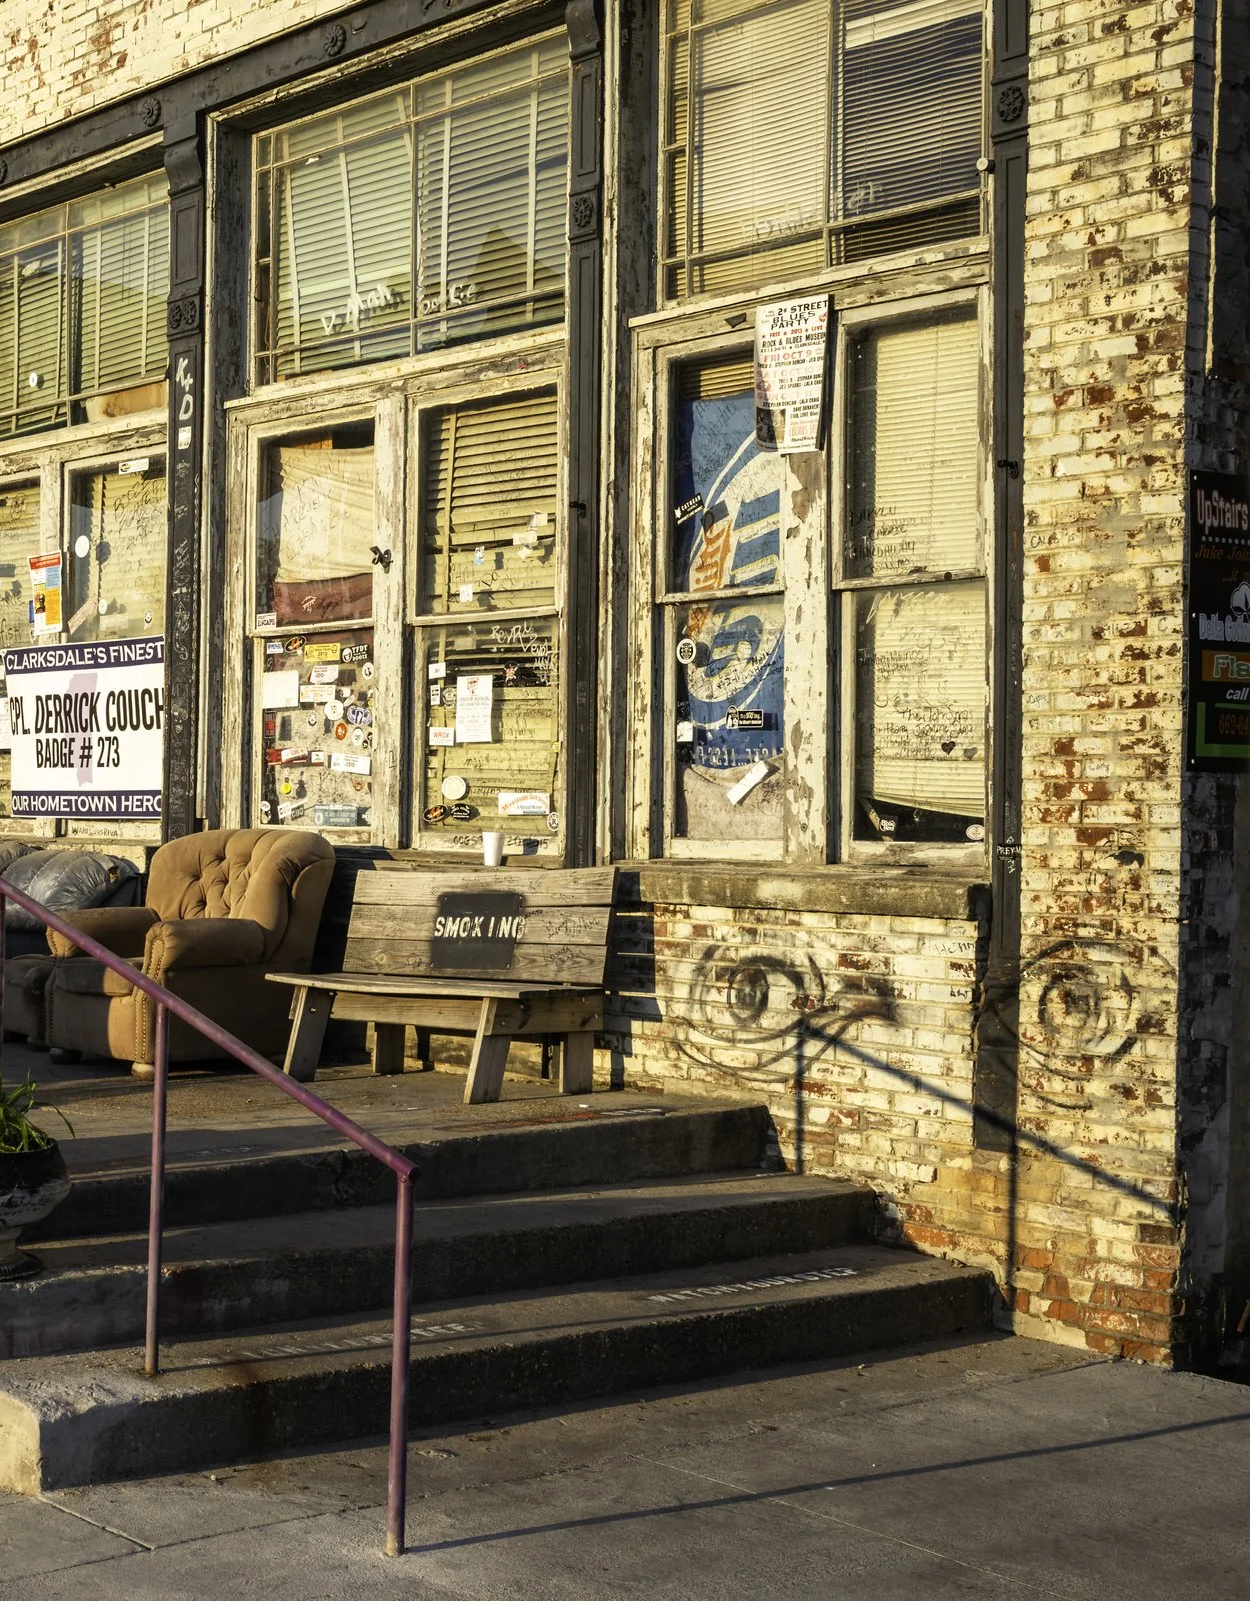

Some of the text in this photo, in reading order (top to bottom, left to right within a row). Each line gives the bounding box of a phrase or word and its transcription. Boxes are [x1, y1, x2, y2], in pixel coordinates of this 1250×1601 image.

[790, 300, 828, 314] STREET
[770, 318, 809, 331] PARTY
[772, 311, 816, 324] BLUES
[762, 340, 776, 349] ROCK
[786, 335, 803, 345] BLUES
[763, 353, 780, 363] FRI
[783, 350, 803, 360] OCT
[1197, 489, 1249, 535] UpStairs
[1195, 544, 1223, 560] Juke
[1199, 612, 1225, 641] Delta
[6, 641, 164, 671] CLARKSDALE'S FINEST
[1225, 687, 1249, 702] call
[9, 687, 164, 736] CPL. DERRICK COUCH
[36, 736, 121, 769] BADGE # 273
[12, 795, 30, 811] OUR
[30, 795, 118, 812] HOMETOWN
[434, 916, 525, 939] SMOKING
[646, 1284, 739, 1303] WATCH
[798, 1266, 857, 1282] STEP
